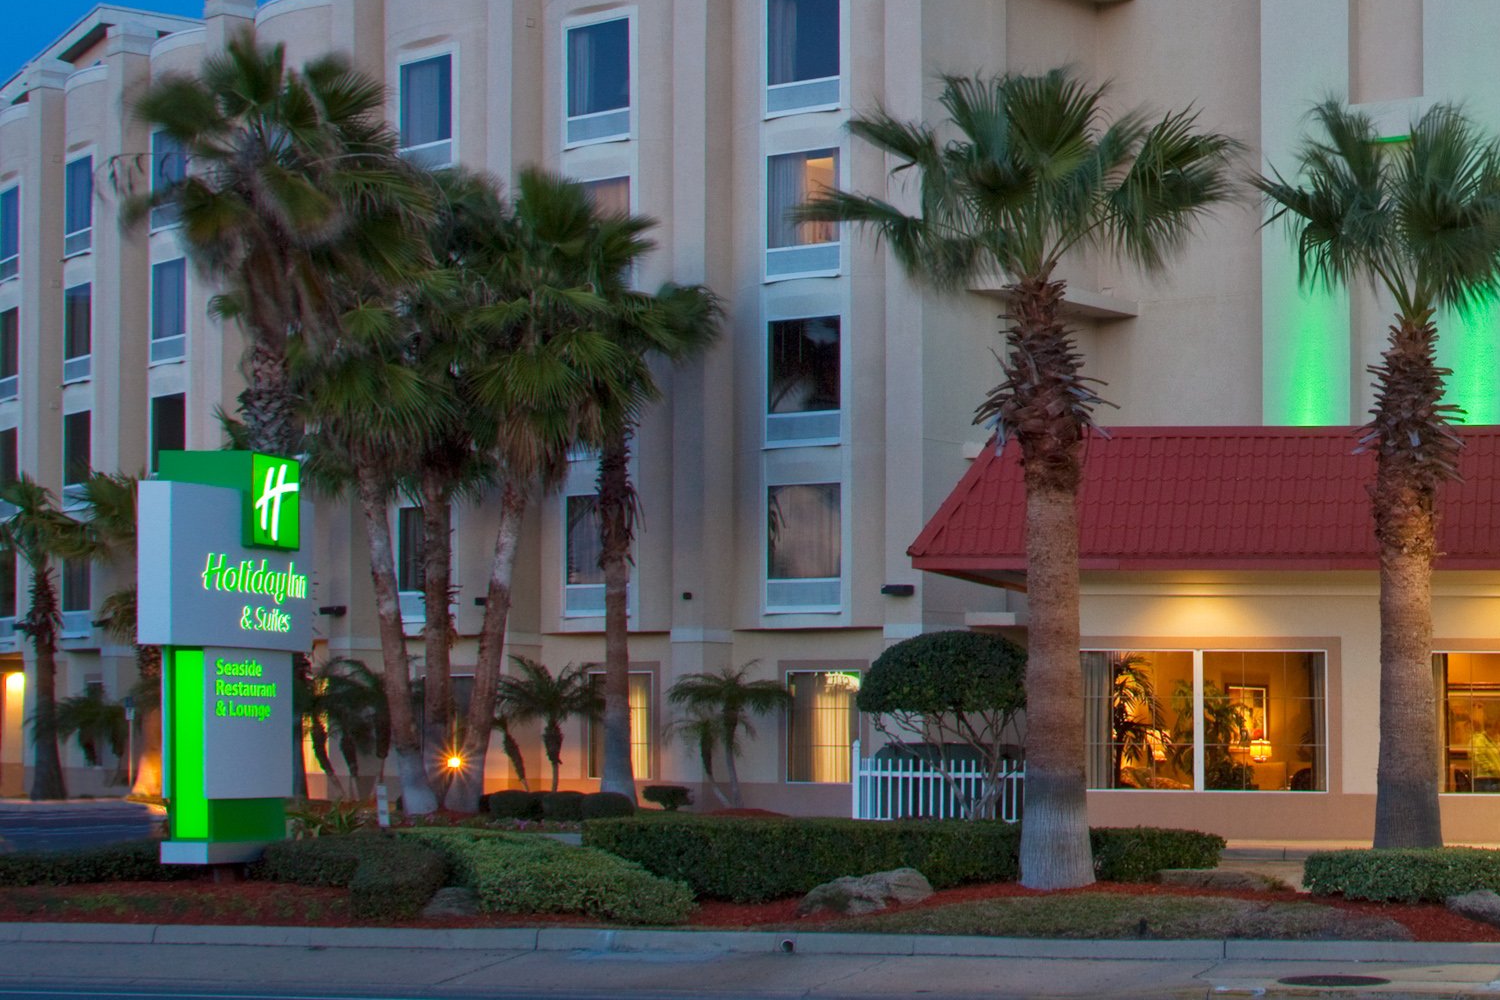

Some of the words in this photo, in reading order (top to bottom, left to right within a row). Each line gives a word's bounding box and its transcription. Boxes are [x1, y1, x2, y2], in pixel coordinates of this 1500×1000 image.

[255, 464, 299, 541] H
[201, 552, 287, 605] Holiday
[287, 561, 308, 599] Inn
[240, 605, 252, 630] &
[254, 606, 291, 632] Suites
[215, 658, 263, 678] Seaside
[215, 678, 276, 697] Restaurant
[215, 699, 227, 717] &
[228, 700, 271, 721] Lounge
